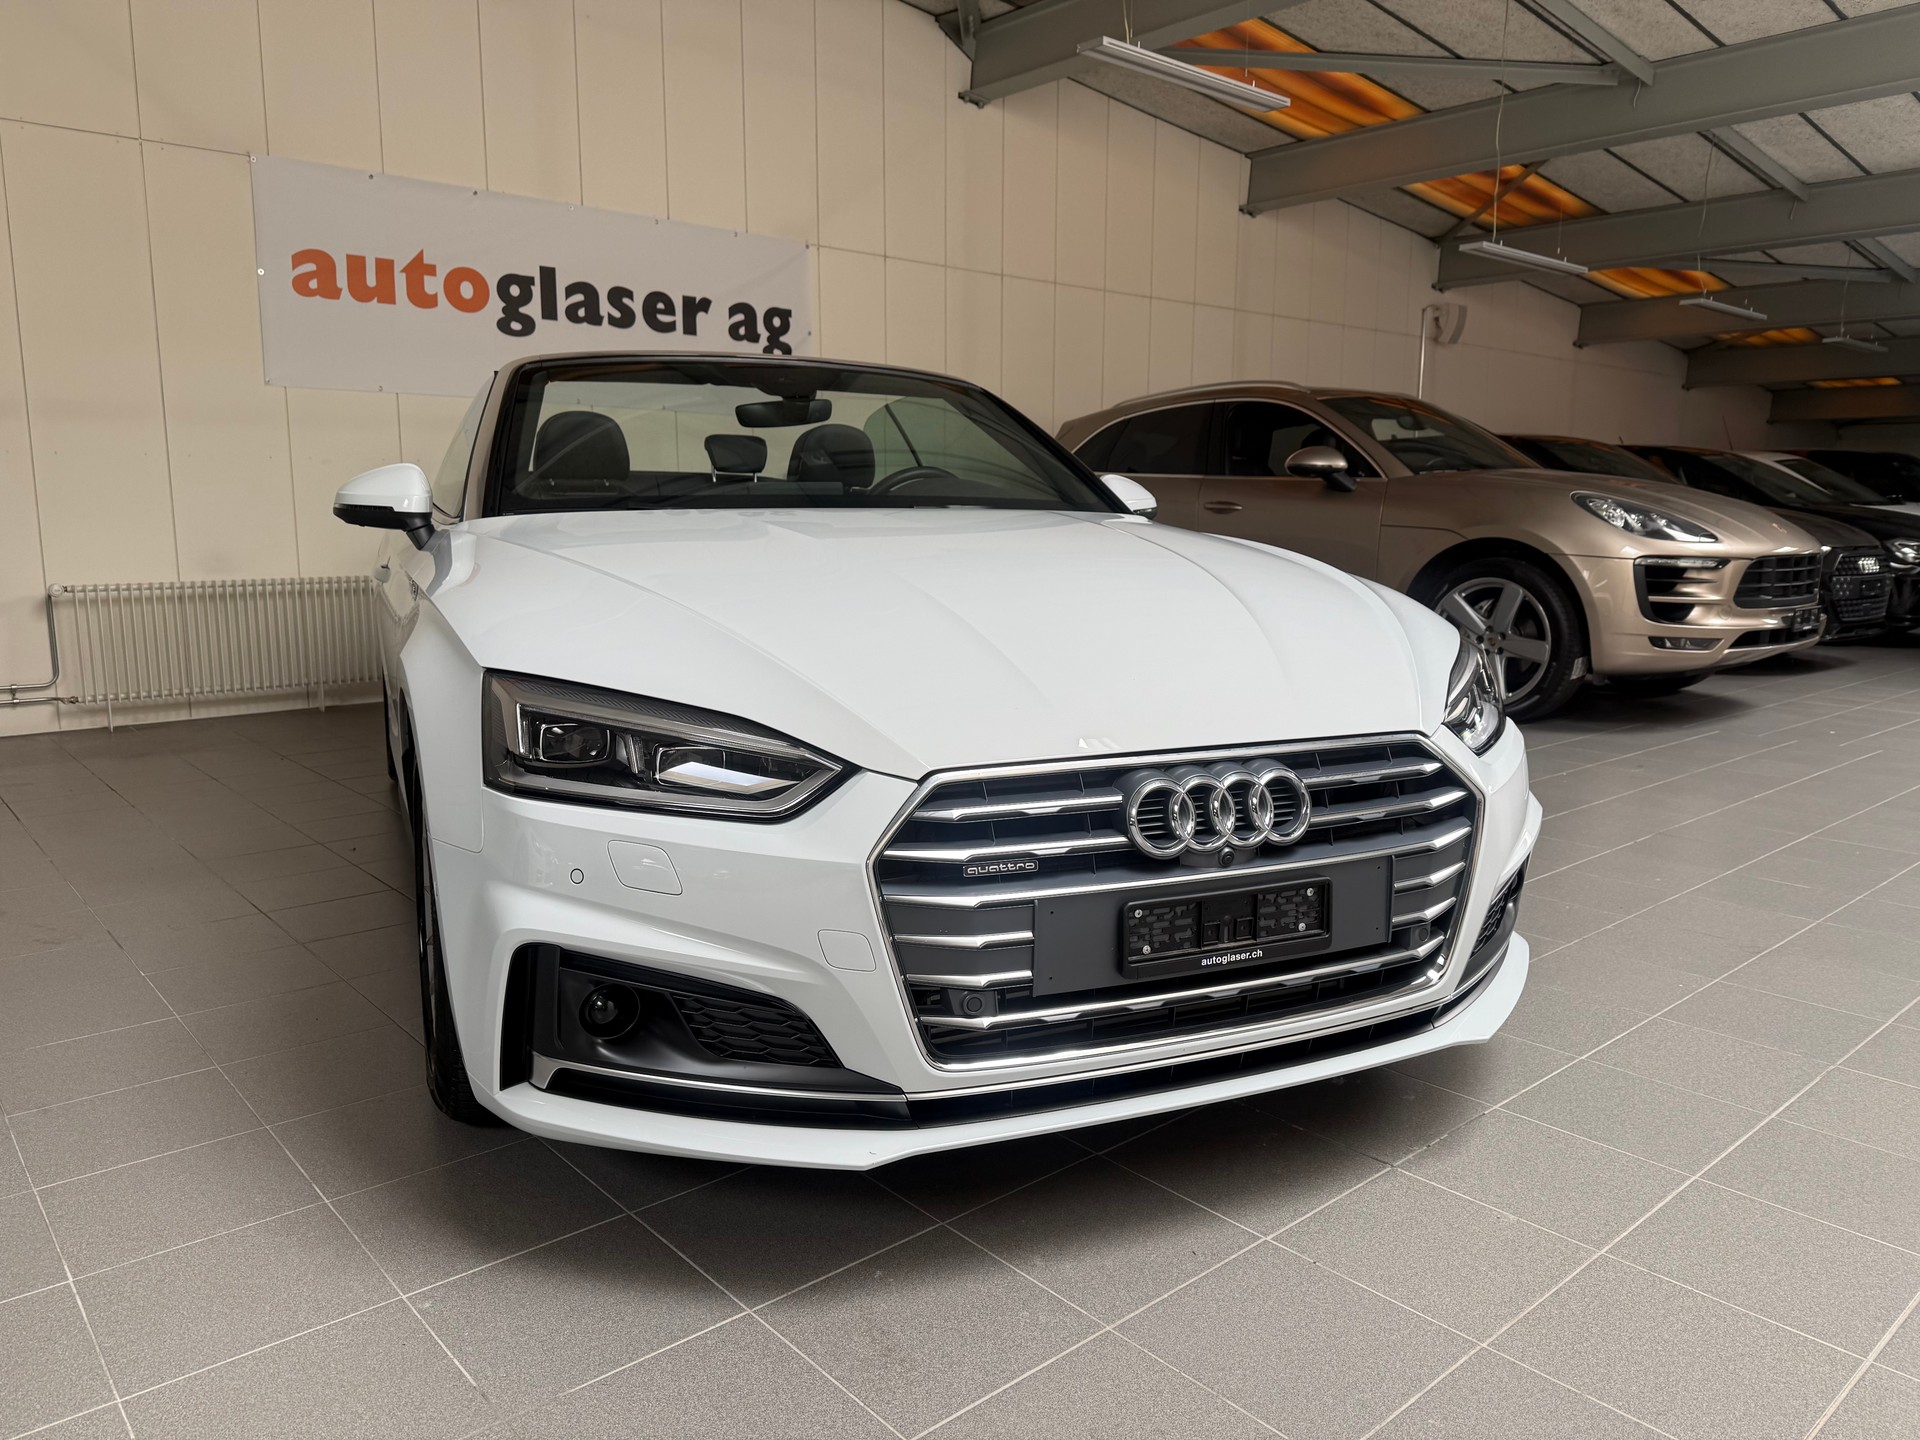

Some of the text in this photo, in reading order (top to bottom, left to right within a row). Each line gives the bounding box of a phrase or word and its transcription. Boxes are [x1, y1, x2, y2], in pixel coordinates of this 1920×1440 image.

[291, 248, 792, 355] autoglaser ag
[967, 862, 1035, 875] quattro
[1201, 949, 1263, 966] autoglaser.ch
